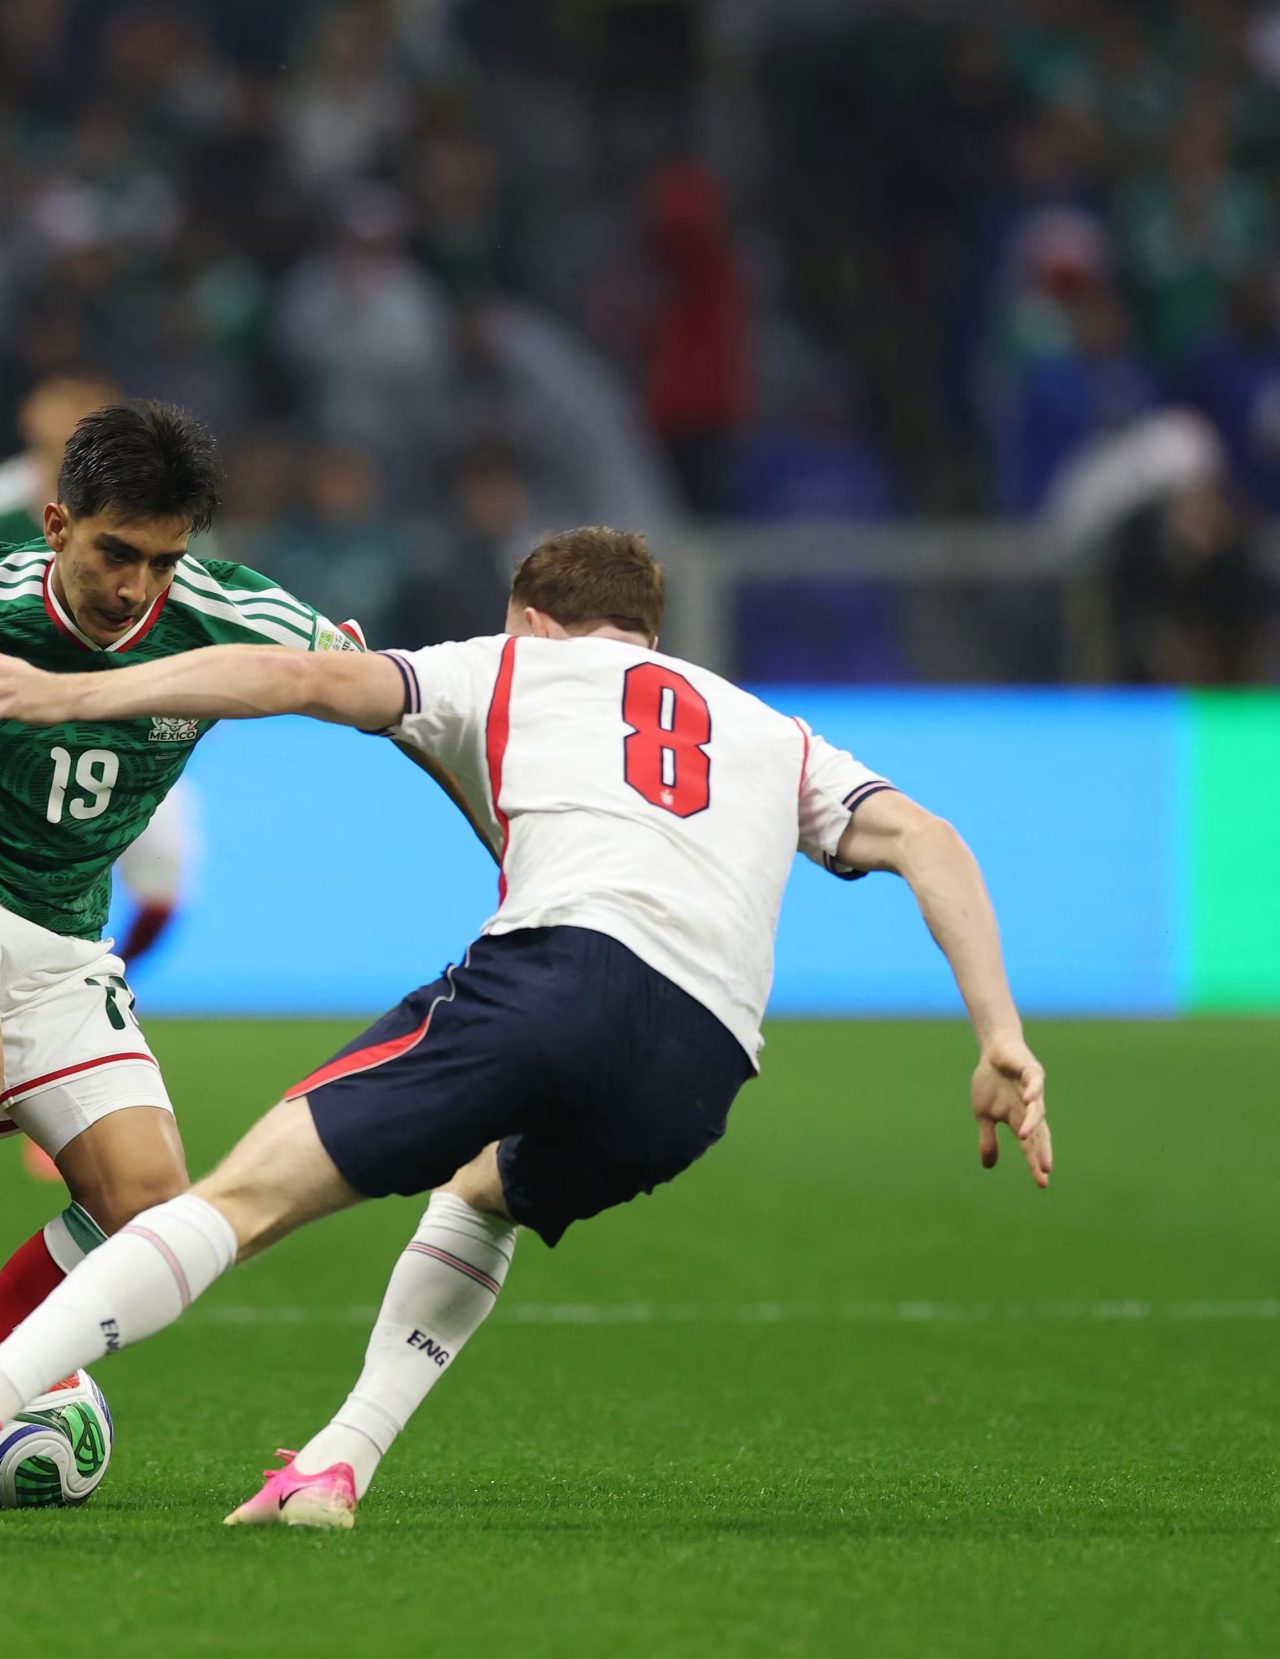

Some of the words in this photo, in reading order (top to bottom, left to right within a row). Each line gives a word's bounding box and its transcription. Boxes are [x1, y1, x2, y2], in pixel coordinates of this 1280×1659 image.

[622, 662, 712, 819] 8
[46, 746, 119, 824] 19
[406, 1330, 450, 1368] ENG
